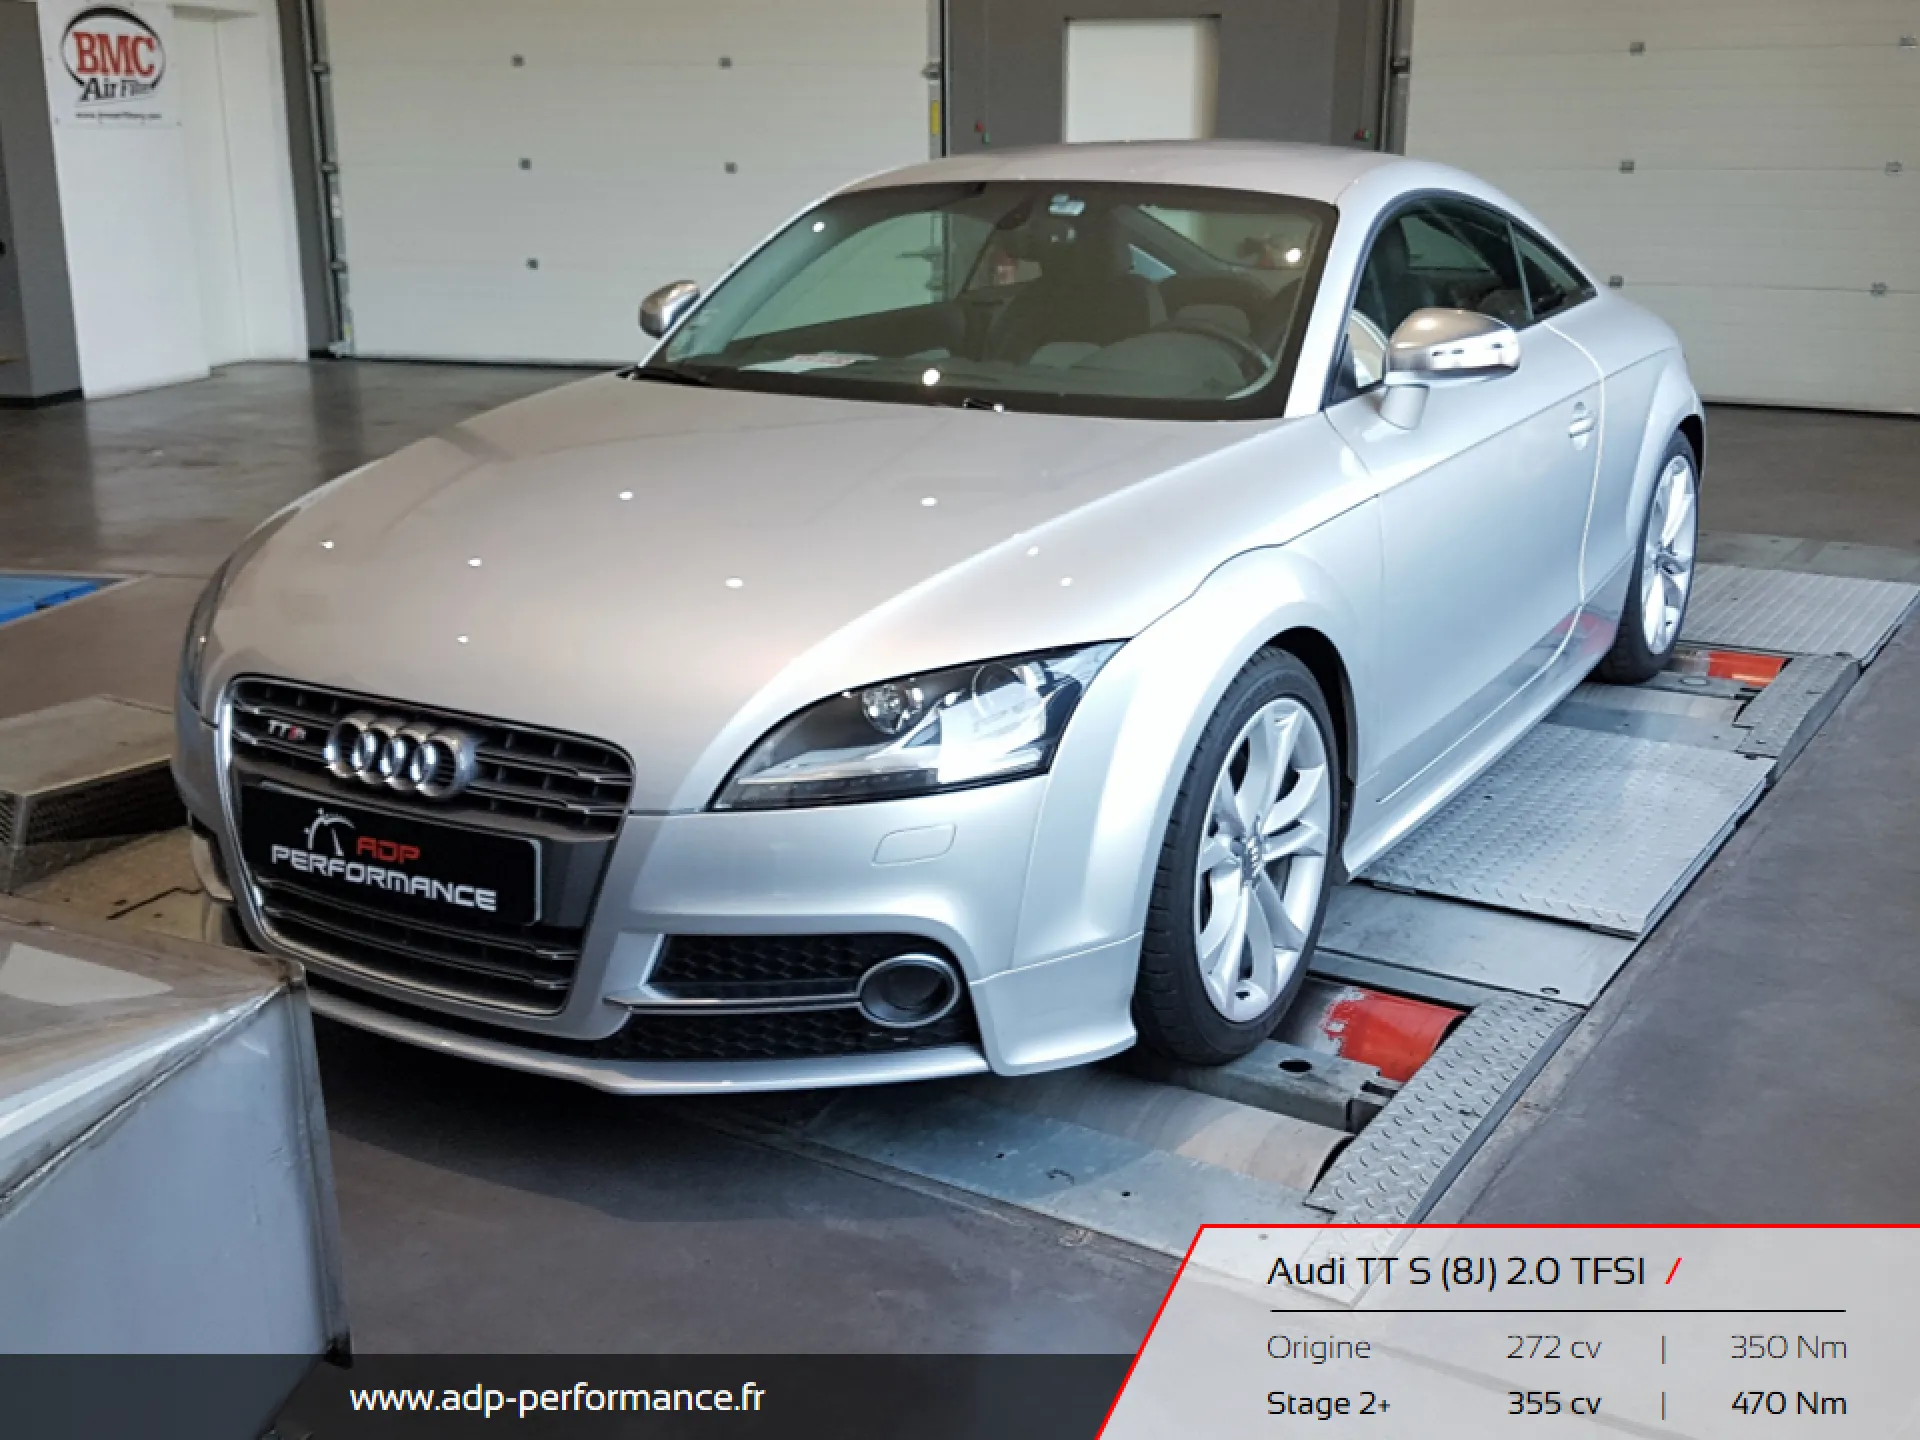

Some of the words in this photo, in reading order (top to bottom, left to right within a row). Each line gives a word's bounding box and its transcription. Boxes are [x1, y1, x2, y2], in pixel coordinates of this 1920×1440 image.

[72, 31, 156, 77] BMC
[80, 77, 118, 102] Air
[356, 835, 421, 864] ADP
[270, 843, 498, 913] PERFORMANCE
